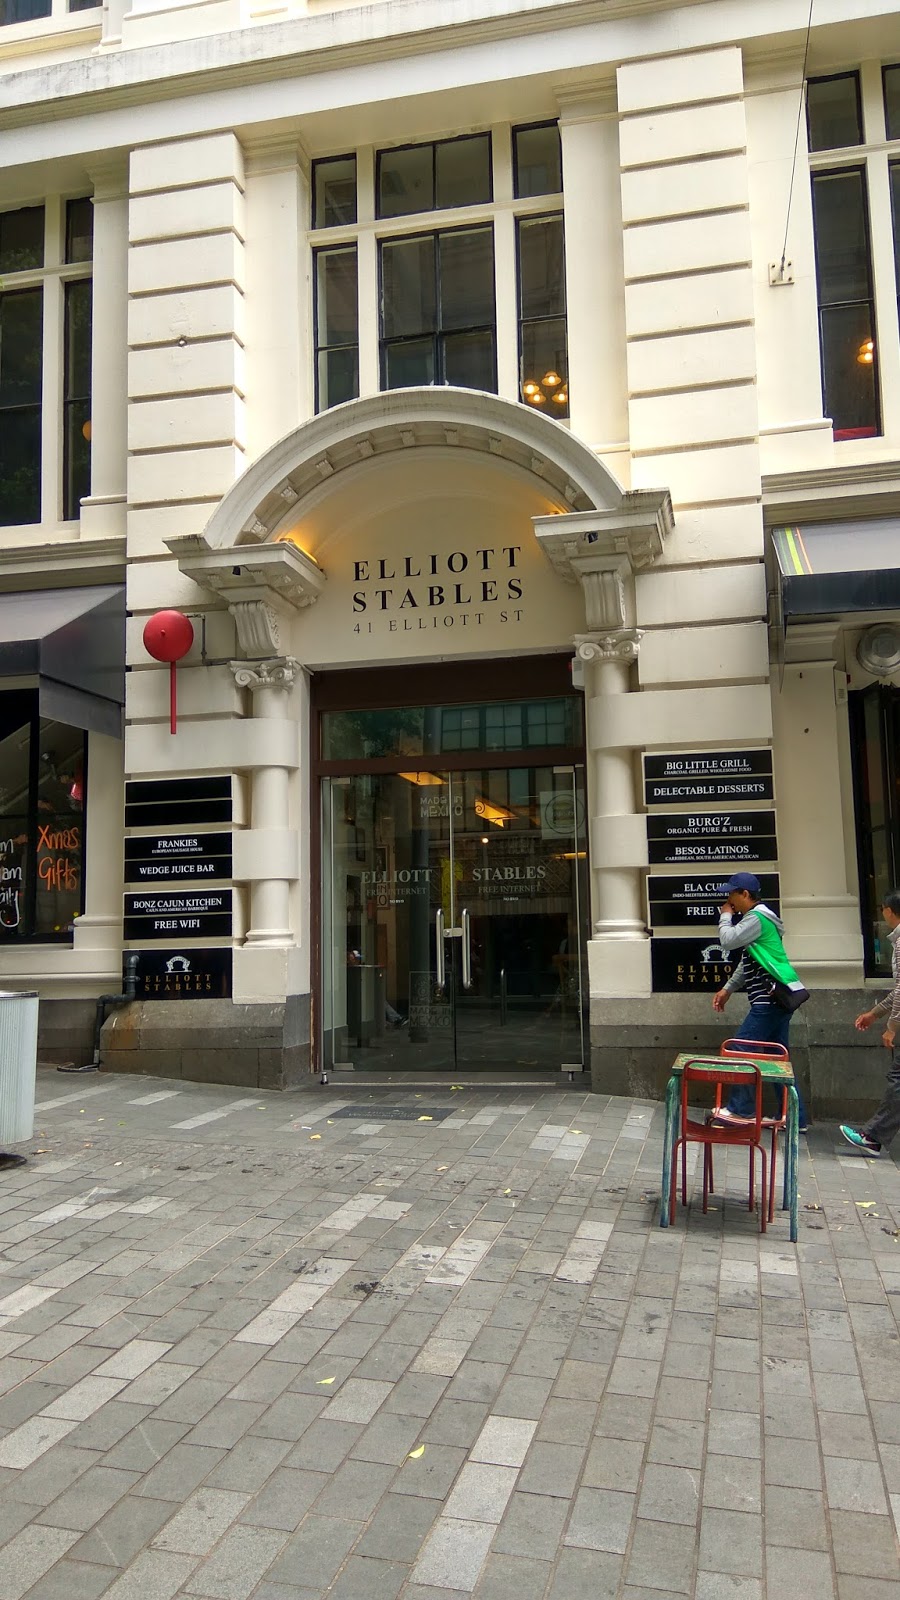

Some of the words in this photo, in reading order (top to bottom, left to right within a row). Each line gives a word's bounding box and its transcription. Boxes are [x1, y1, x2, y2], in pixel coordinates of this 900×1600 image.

[353, 546, 521, 581] ELLIOTT
[352, 578, 523, 613] STABLES
[353, 622, 373, 634] 41
[389, 612, 485, 632] ELLIOTT
[500, 609, 524, 623] ST
[666, 762, 683, 770] BIG
[685, 760, 718, 769] LITTLE
[720, 759, 749, 768] GRILL
[654, 785, 715, 796] DELECTABLE
[717, 783, 765, 794] DESSERTS
[420, 796, 447, 805] MADE
[453, 795, 463, 804] IN
[420, 805, 463, 818] MEXIO
[688, 816, 731, 827] BURG'Z
[36, 824, 79, 853] Xmas
[158, 839, 198, 849] FRANKIES
[675, 847, 706, 855] BESOS
[708, 845, 749, 854] LATINOS
[38, 856, 77, 892] Gifts
[139, 866, 170, 875] WEDGE
[171, 865, 195, 874] JUICE
[196, 864, 215, 873] BAR
[361, 869, 433, 884] ELLIOTT
[472, 866, 546, 881] STABLES
[478, 885, 498, 894] FREE
[500, 884, 541, 893] INTERNET
[684, 883, 703, 892] ELA
[0, 886, 20, 928] aily
[133, 901, 156, 909] BONZ
[157, 899, 184, 908] CAJUN
[186, 898, 222, 907] KITCHEN
[687, 907, 715, 916] FREE
[154, 920, 177, 929] FREE
[180, 919, 200, 928] WIFI
[677, 965, 732, 974] ELLIO
[145, 974, 211, 983] ELLIOTT
[677, 974, 730, 983] STAB
[144, 983, 211, 991] STABLES
[410, 1016, 450, 1026] MEXICO
